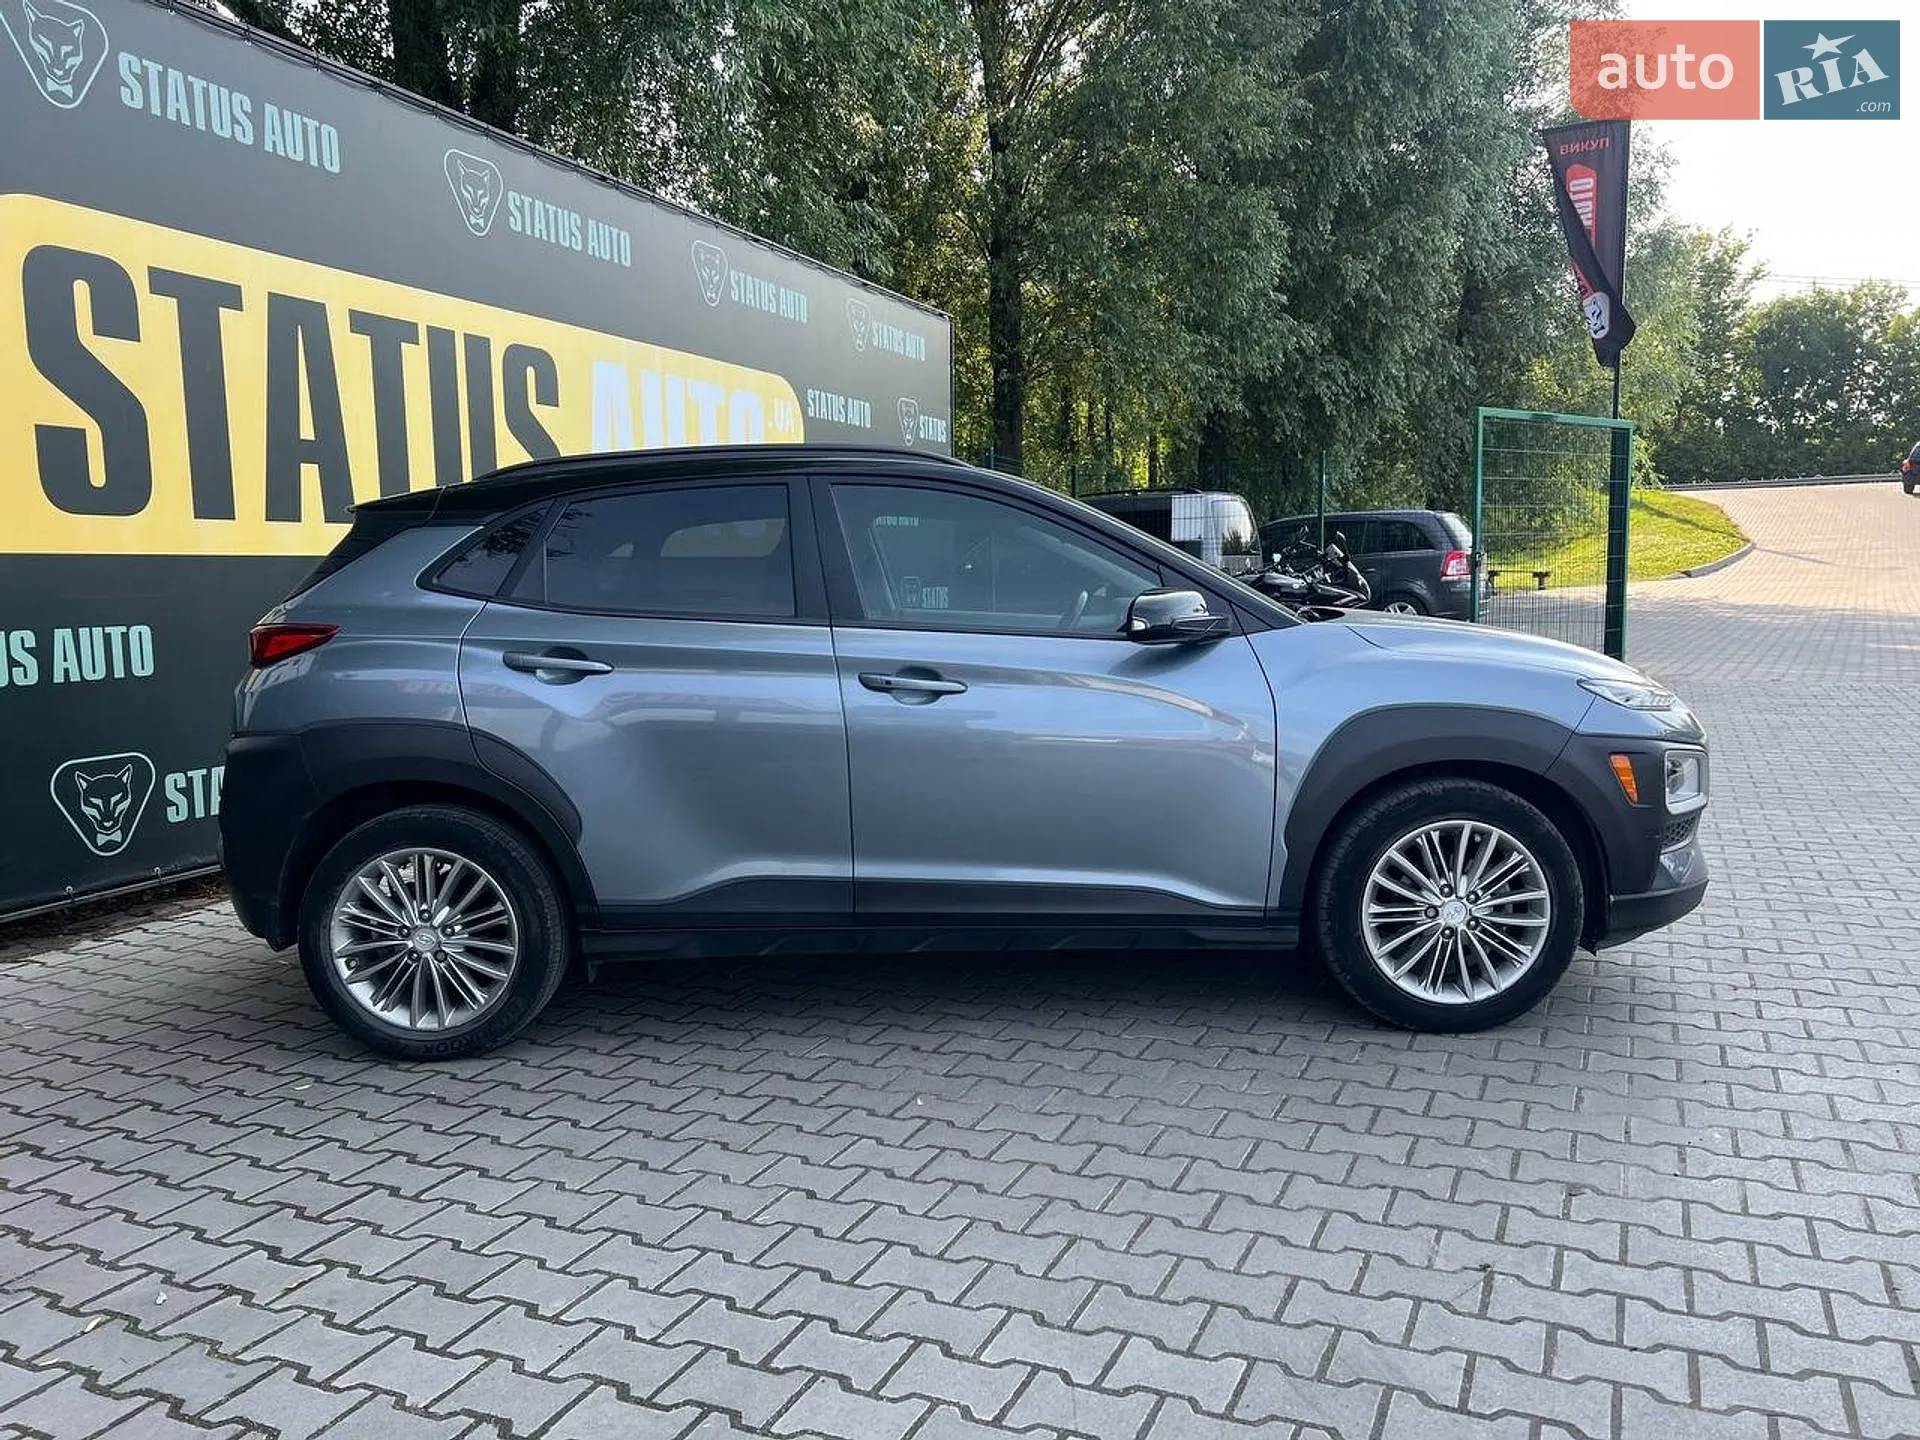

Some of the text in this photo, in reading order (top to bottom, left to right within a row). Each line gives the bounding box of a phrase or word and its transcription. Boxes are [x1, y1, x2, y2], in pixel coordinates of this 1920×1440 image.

[118, 52, 341, 173] STATUS AUTO
[1560, 137, 1610, 155] ВИКУП
[507, 190, 631, 267] STATUS AUTO
[730, 269, 808, 323] STATUS AUTO
[872, 320, 925, 361] STATUS AUTO
[22, 244, 561, 523] STATUS
[806, 389, 871, 428] STATUS AUTO
[920, 415, 947, 443] STATUS
[53, 625, 154, 683] AUTO
